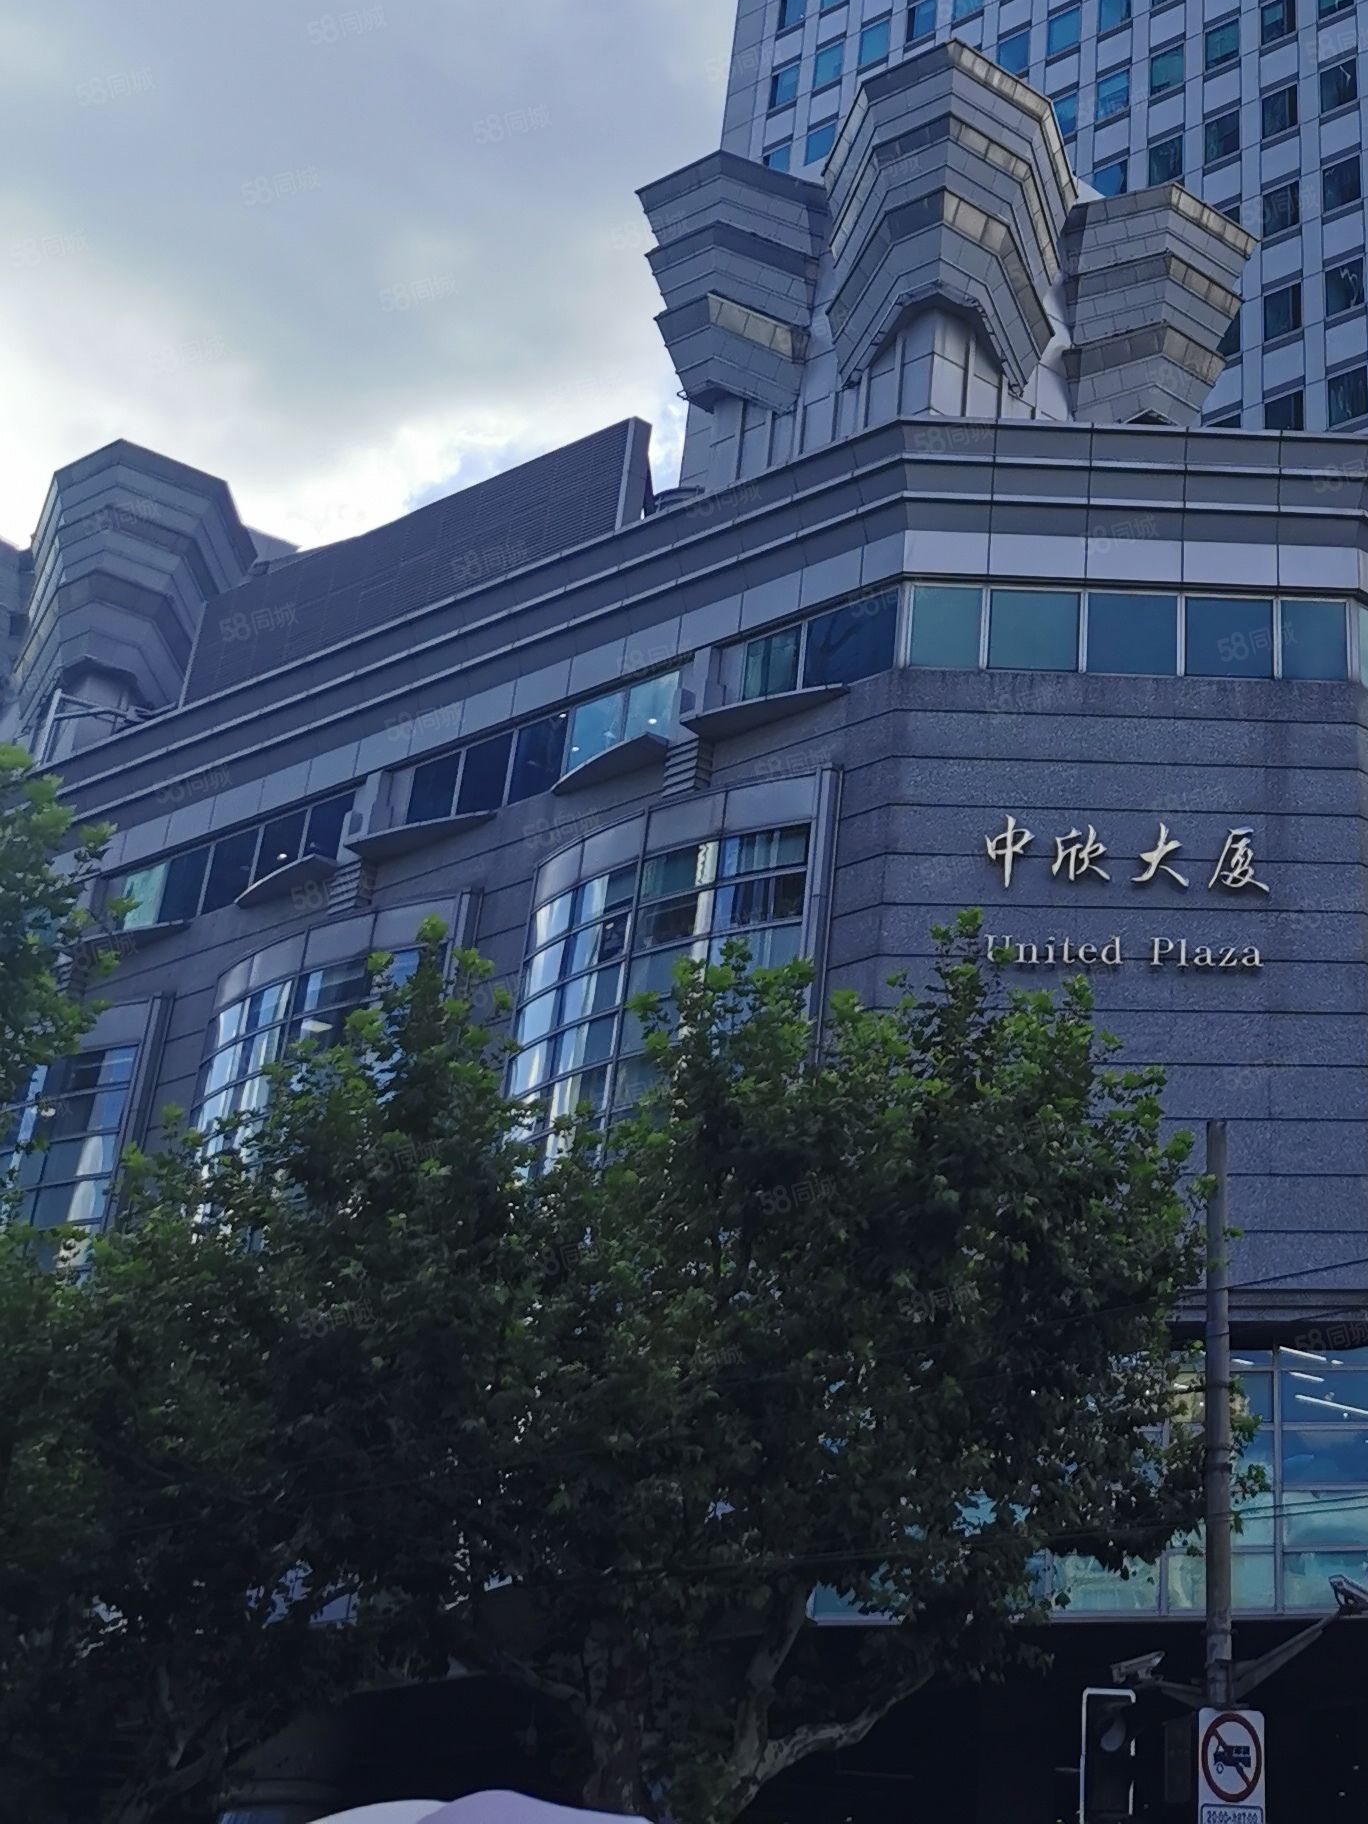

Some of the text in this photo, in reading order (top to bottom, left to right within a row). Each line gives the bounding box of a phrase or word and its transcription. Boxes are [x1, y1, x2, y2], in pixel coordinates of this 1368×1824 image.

[985, 814, 1270, 893] 中欣大厦
[984, 934, 1265, 968] United Plaza
